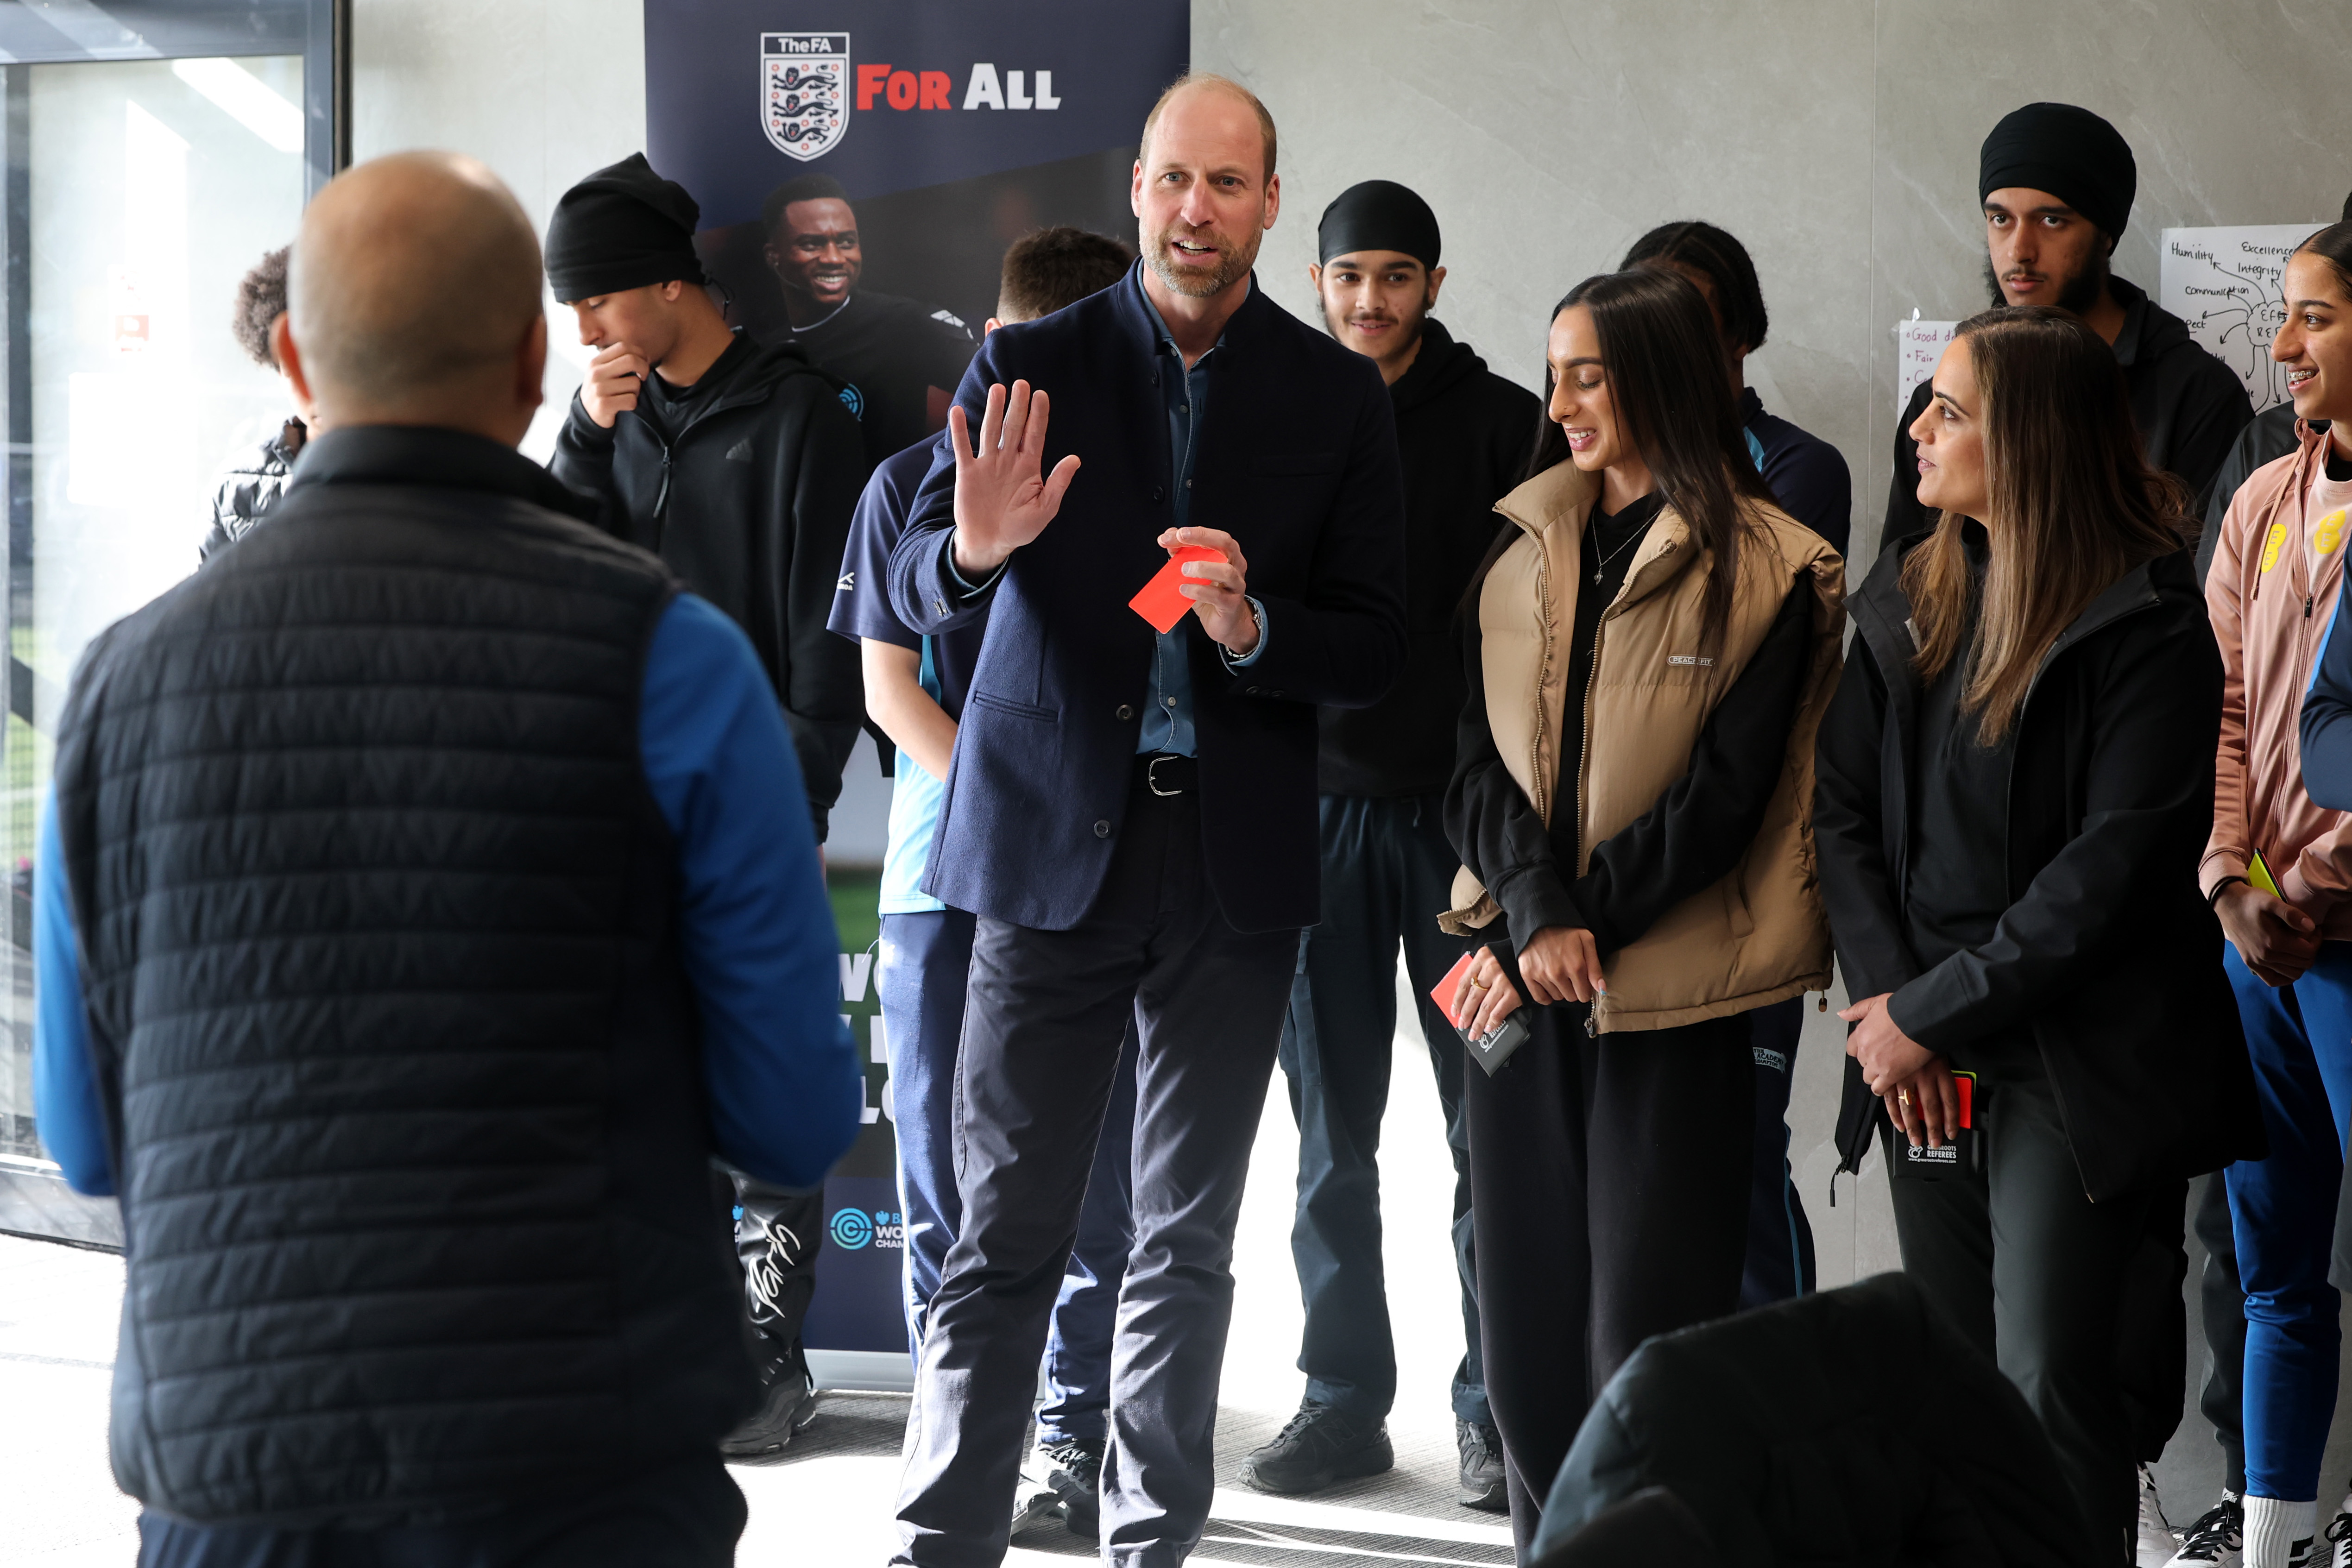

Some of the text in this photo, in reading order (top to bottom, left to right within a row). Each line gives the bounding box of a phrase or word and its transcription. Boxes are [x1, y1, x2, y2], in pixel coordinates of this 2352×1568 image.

[2172, 242, 2213, 265] Humility
[2238, 261, 2281, 281] Integrity
[1912, 327, 1937, 342] Good
[1916, 350, 1934, 362] Fair
[1927, 1150, 1956, 1159] REFEREES
